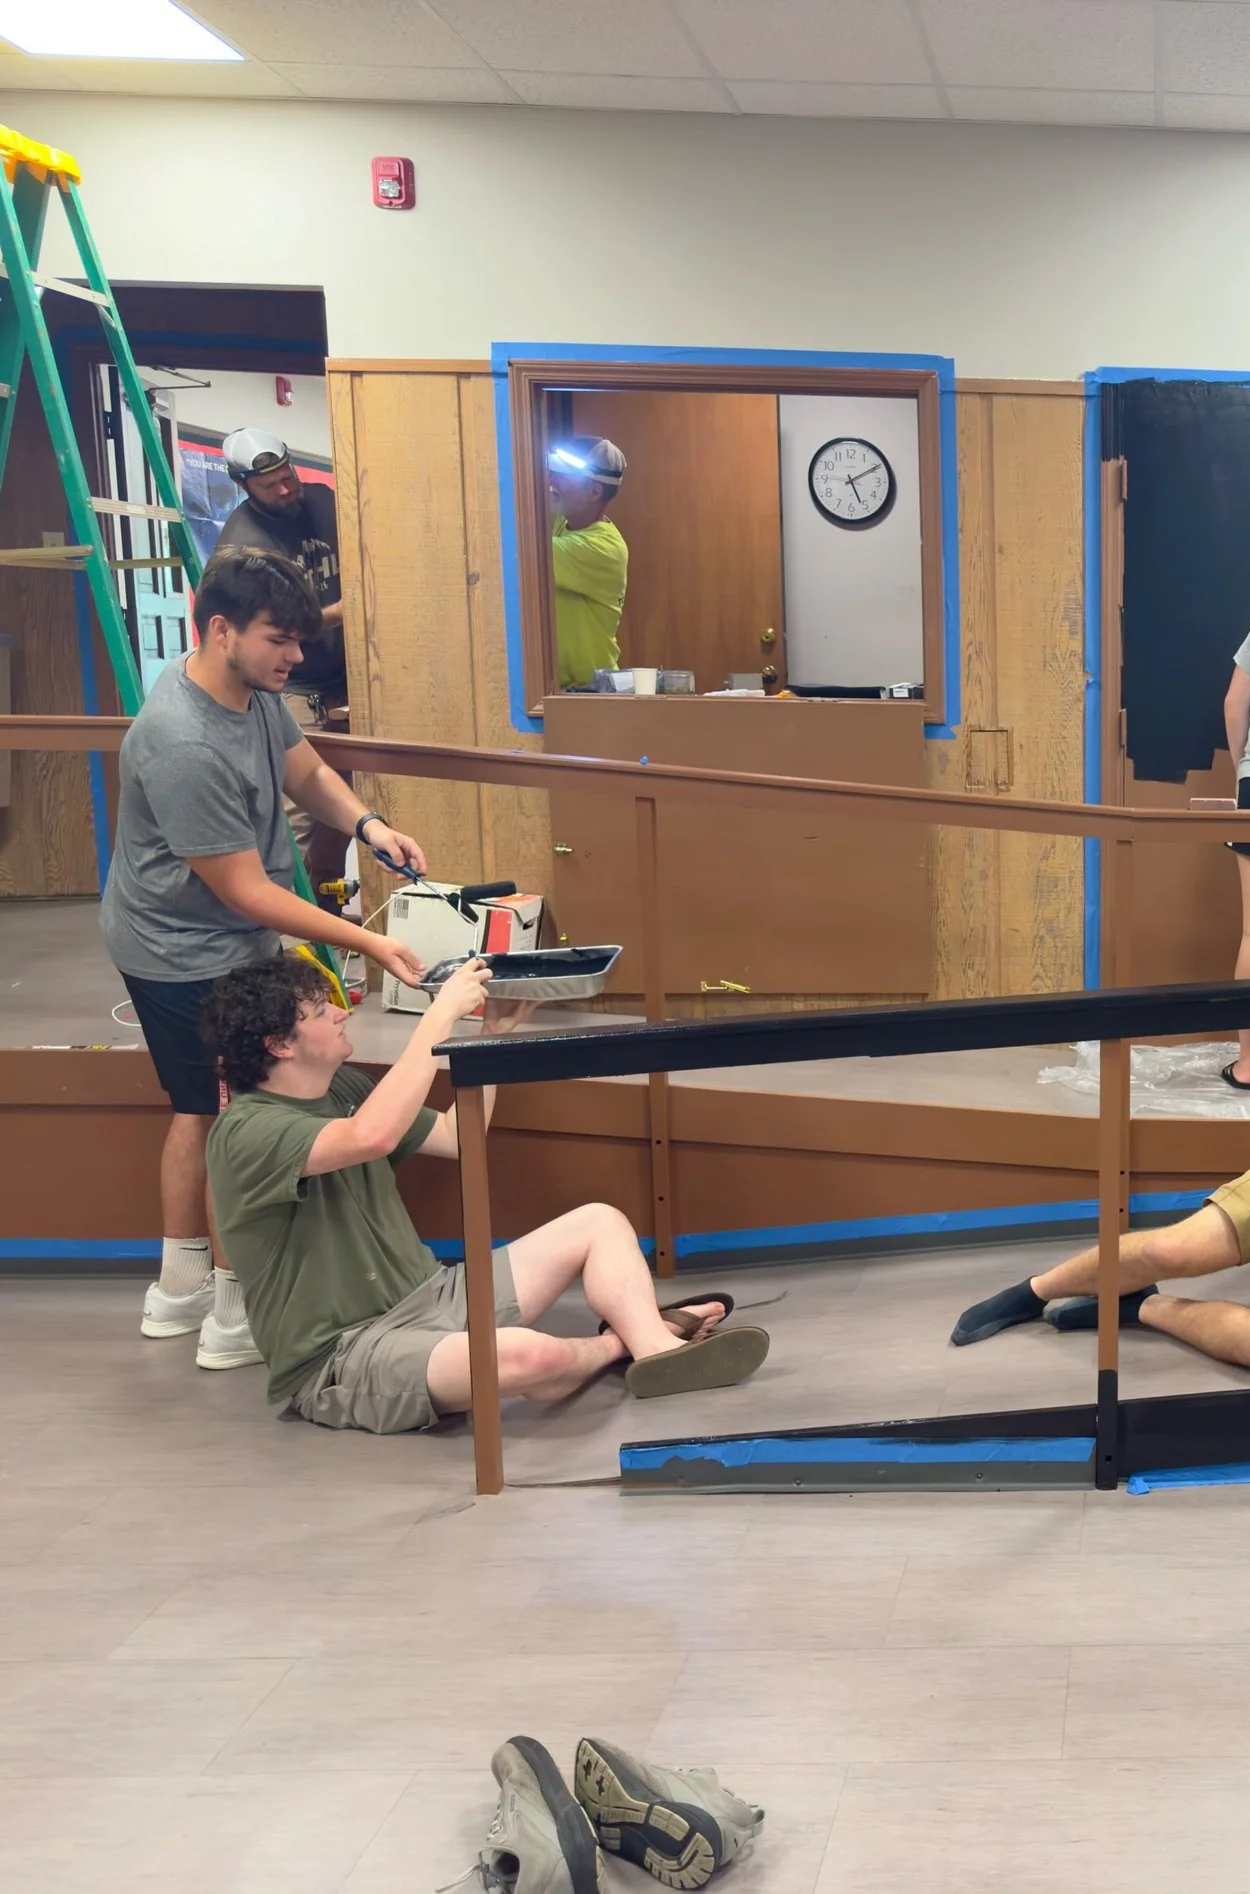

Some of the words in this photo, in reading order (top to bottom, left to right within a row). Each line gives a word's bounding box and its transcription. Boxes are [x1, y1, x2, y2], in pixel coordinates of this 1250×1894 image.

[835, 452, 841, 462] 11
[846, 449, 856, 459] 12
[824, 461, 834, 471] 10
[821, 475, 828, 484] 9
[875, 478, 881, 487] 3
[825, 488, 833, 497] 8
[870, 490, 876, 500] 4
[836, 499, 842, 508] 7
[848, 503, 855, 512] 6
[862, 500, 869, 510] 5
